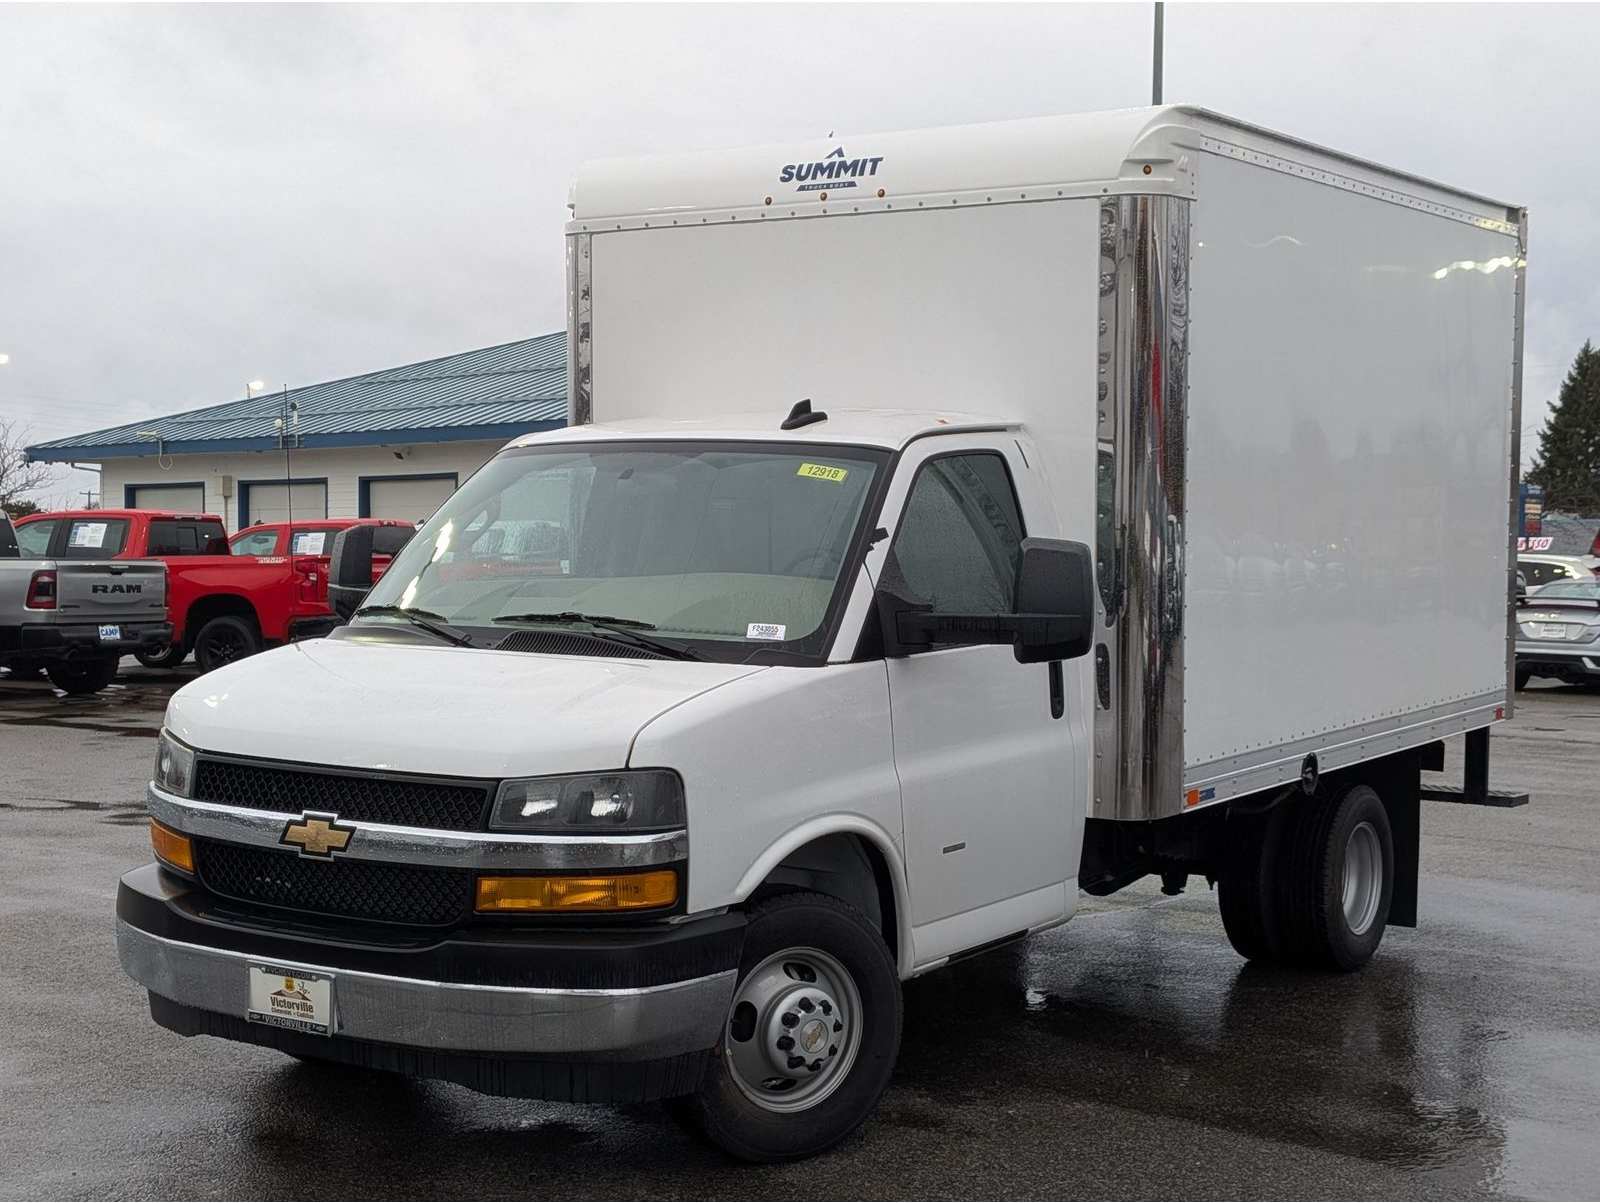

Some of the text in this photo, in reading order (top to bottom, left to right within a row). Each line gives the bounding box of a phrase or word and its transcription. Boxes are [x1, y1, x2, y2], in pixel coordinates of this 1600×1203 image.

[779, 157, 884, 183] SUMMIT
[807, 465, 840, 479] 12918
[92, 584, 142, 594] RAM
[100, 628, 119, 636] CAMP
[270, 996, 314, 1013] Victorville
